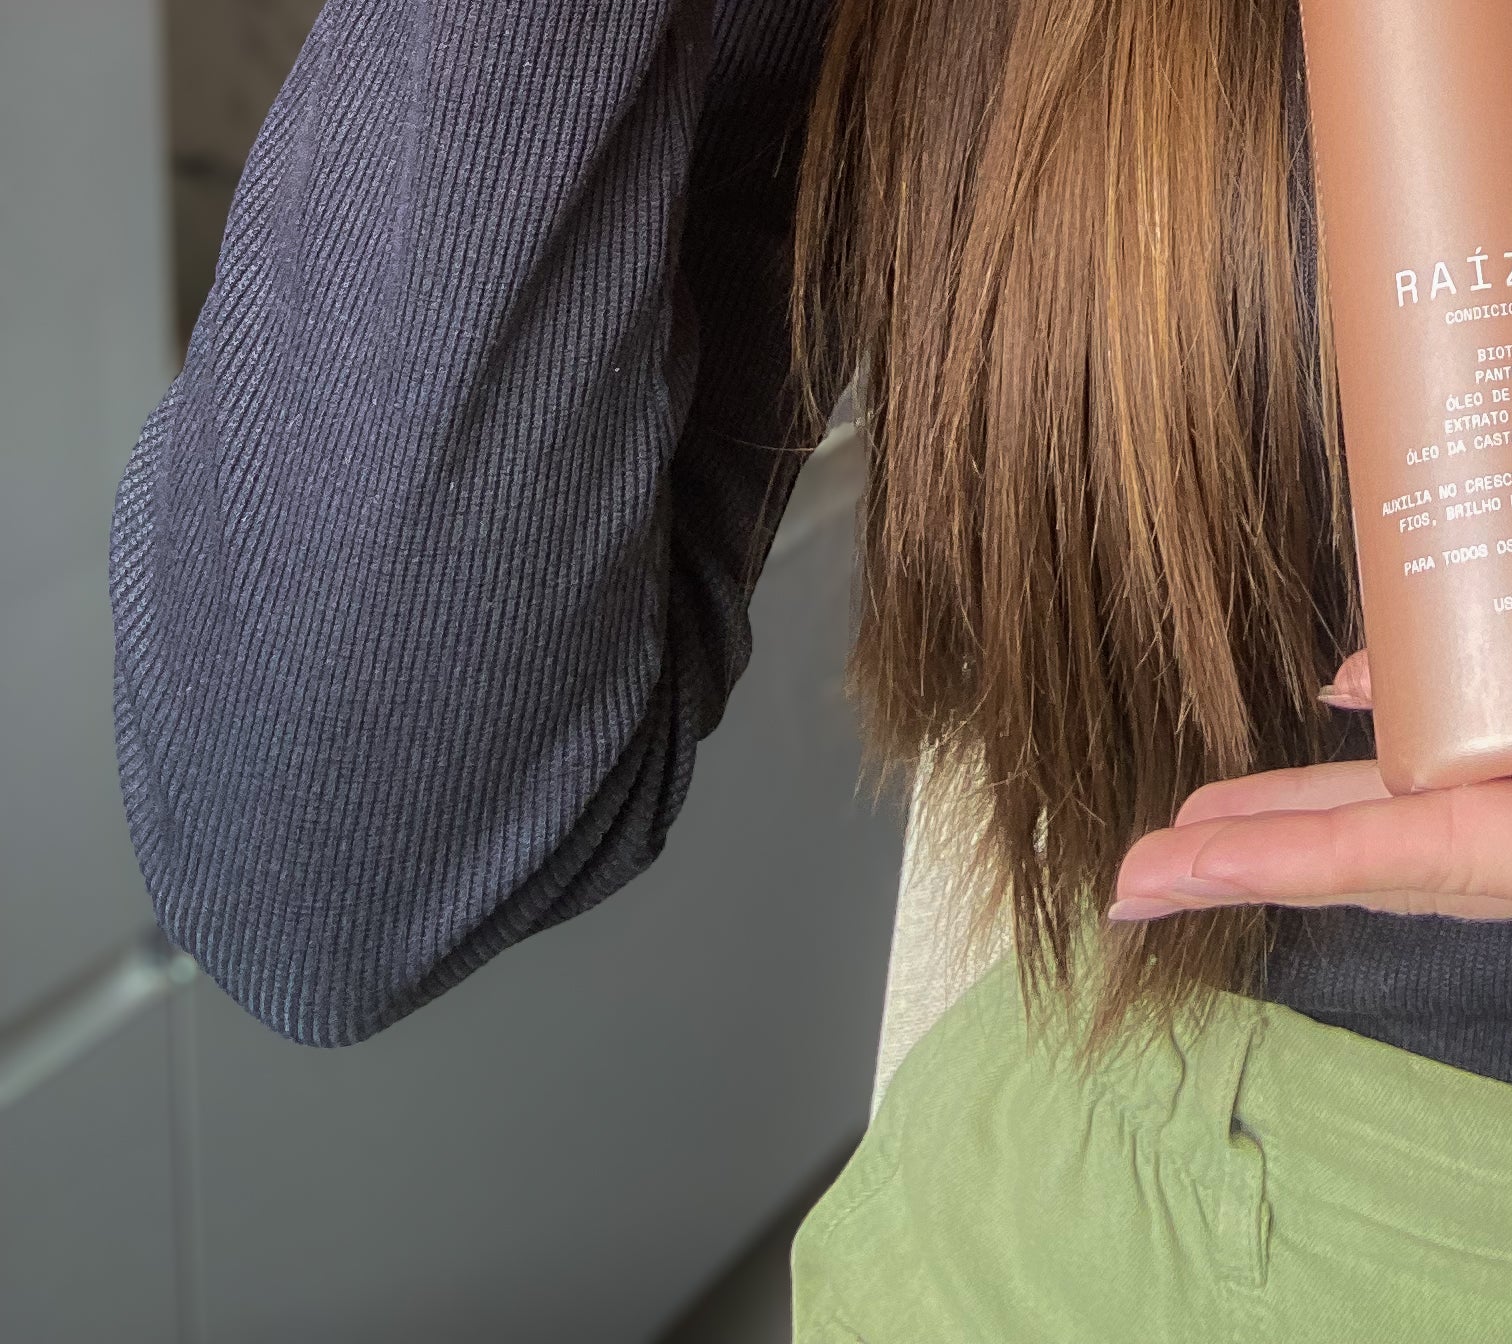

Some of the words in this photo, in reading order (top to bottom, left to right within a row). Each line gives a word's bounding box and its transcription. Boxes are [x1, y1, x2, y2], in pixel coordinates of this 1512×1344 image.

[1446, 391, 1483, 412] ÓLEO
[1492, 387, 1511, 403] DE
[1444, 409, 1509, 434] EXTRATO
[1406, 443, 1440, 466] ÓLEO
[1447, 439, 1467, 457] DA
[1382, 491, 1433, 517] AUXILIA
[1438, 482, 1458, 500] NO
[1399, 513, 1437, 533] FIOS,
[1446, 499, 1502, 522] BRILHO
[1404, 556, 1436, 577] PARA
[1442, 543, 1489, 567] TODOS
